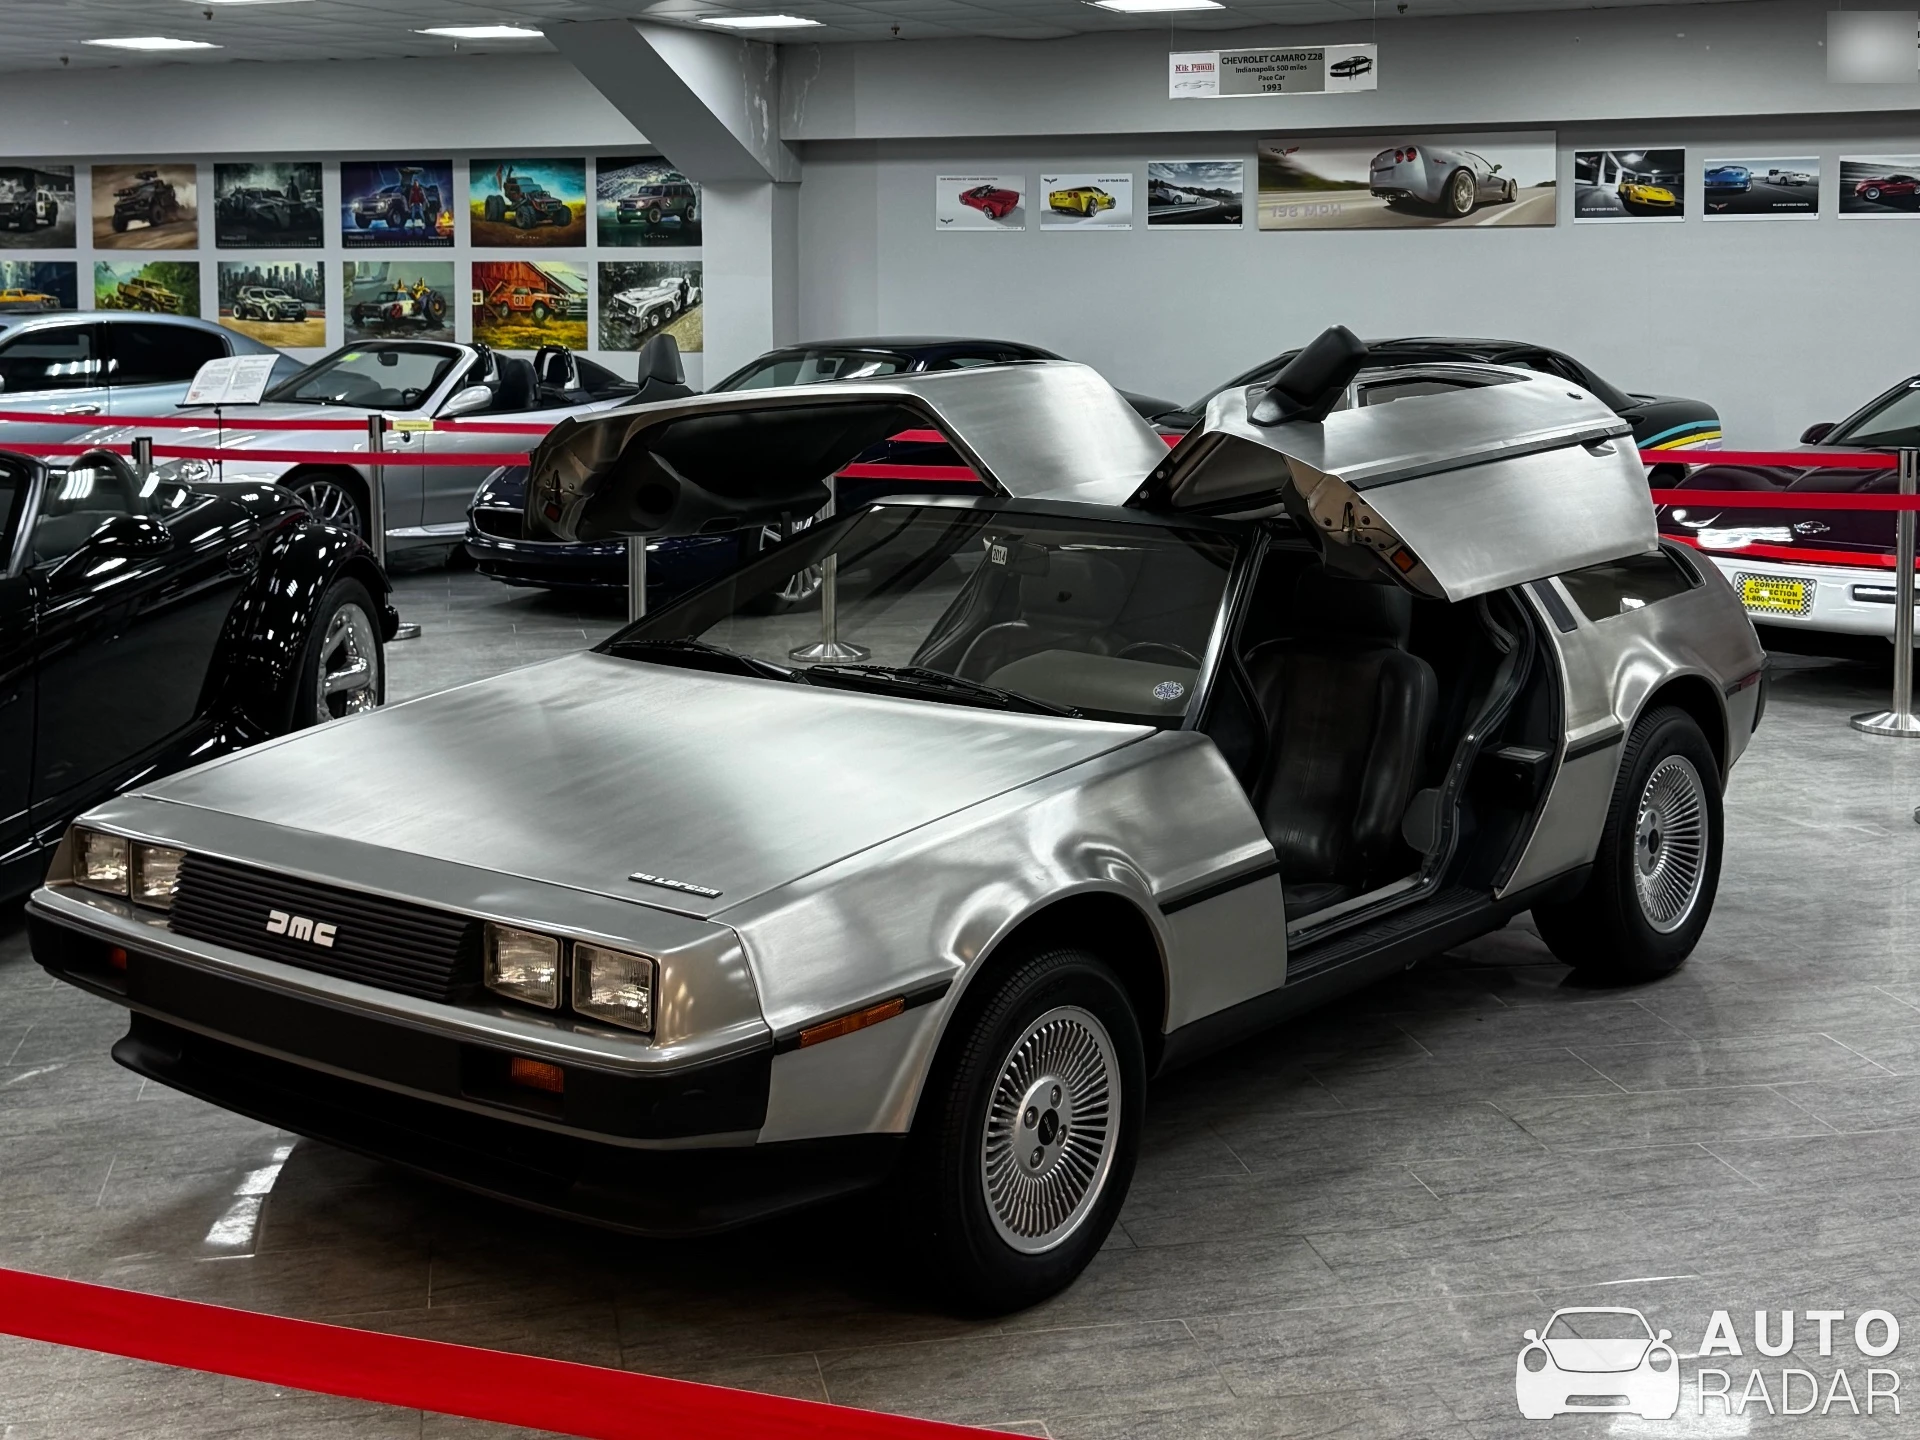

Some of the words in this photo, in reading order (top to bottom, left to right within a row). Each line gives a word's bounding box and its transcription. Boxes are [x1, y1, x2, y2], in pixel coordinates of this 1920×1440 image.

[1221, 55, 1269, 65] CHEVROLET
[1270, 53, 1306, 63] CAMARO
[1307, 52, 1323, 61] Z28
[1235, 66, 1276, 74] Indianapolis
[1276, 64, 1289, 72] 500
[1262, 83, 1282, 91] 1993
[1754, 582, 1794, 590] CORVETTE
[1749, 588, 1798, 597] COECTION
[266, 909, 338, 948] DMC
